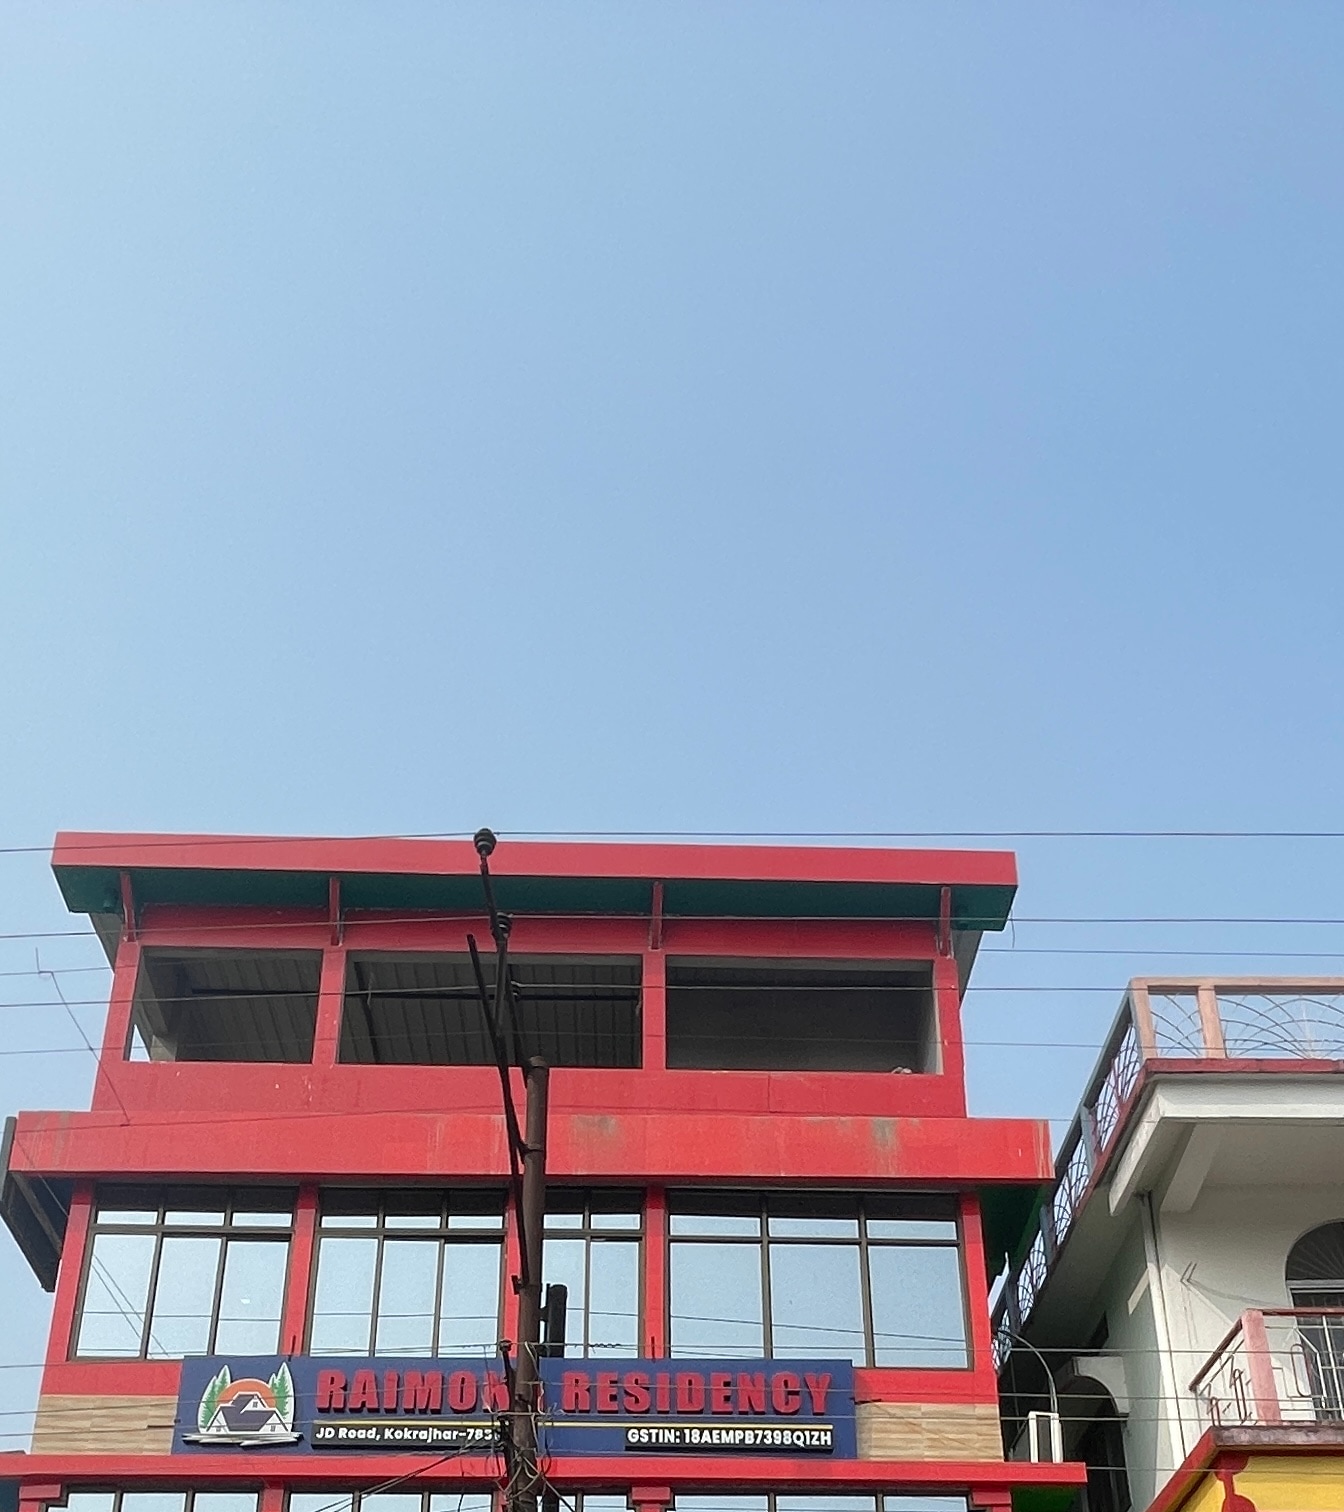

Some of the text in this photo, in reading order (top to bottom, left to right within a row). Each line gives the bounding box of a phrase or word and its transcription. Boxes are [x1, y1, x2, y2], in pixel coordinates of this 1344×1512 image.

[316, 1369, 831, 1415] RAIMON RESIDENCY
[315, 1427, 335, 1440] JD
[338, 1427, 381, 1442] Road,
[627, 1428, 681, 1445] GSTIN:
